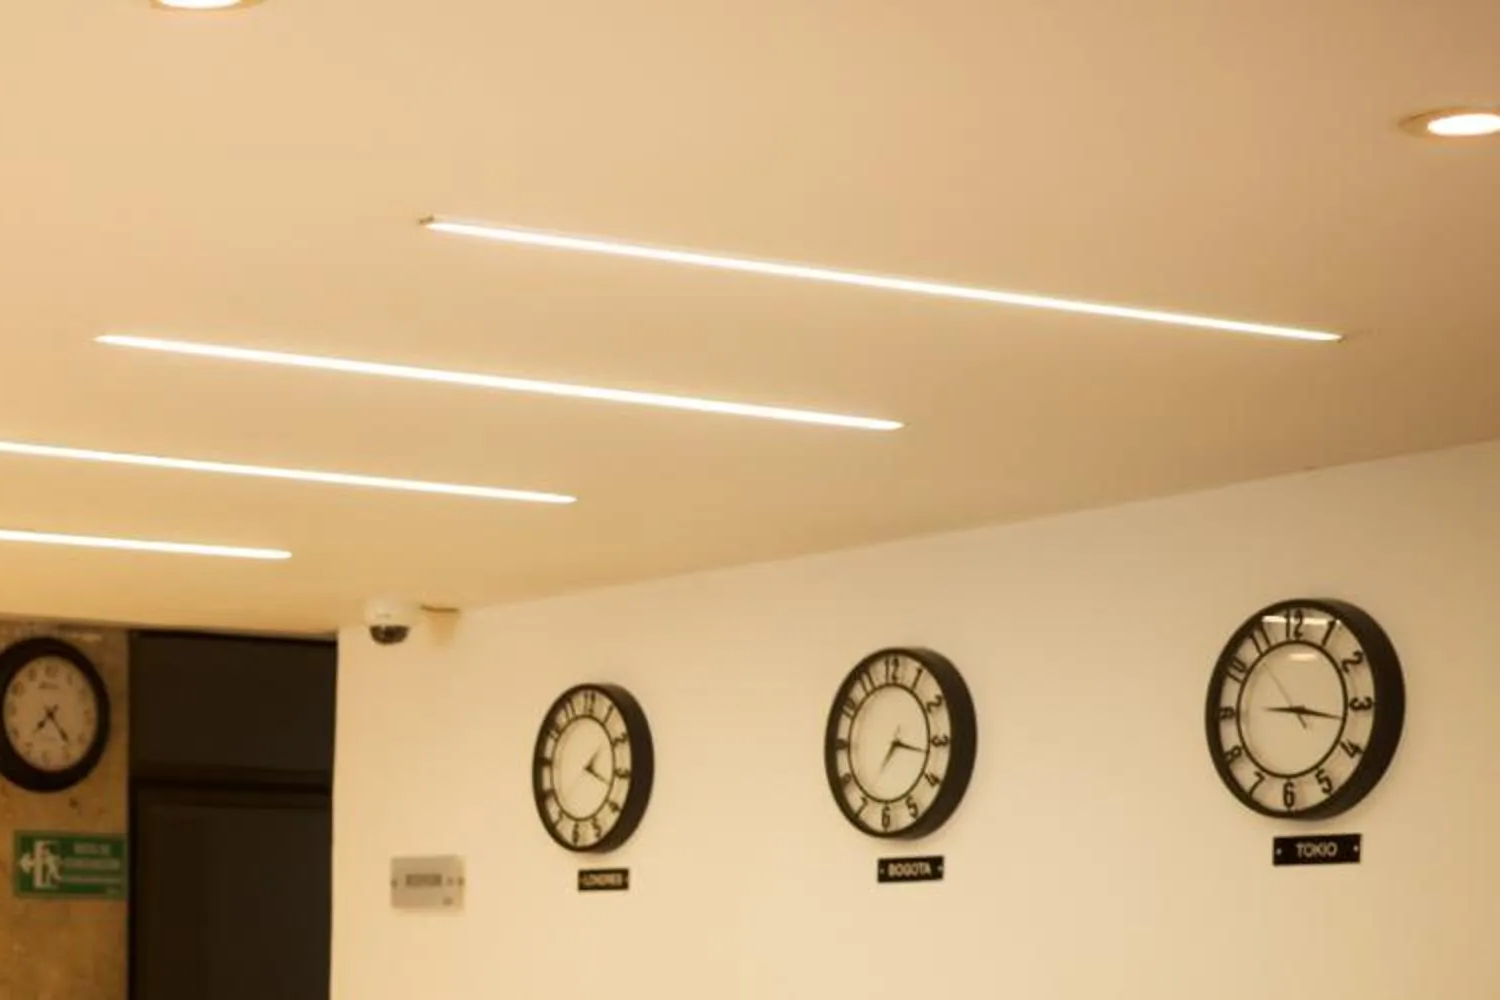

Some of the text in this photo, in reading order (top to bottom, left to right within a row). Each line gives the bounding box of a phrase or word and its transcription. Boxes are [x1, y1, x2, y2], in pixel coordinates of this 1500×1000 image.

[1285, 608, 1304, 638] 12
[1321, 620, 1337, 647] 1
[884, 656, 900, 681] 12
[1340, 651, 1364, 673] 2
[911, 667, 924, 690] 1
[926, 695, 943, 713] 2
[1349, 696, 1373, 713] 3
[930, 734, 950, 748] 3
[1339, 739, 1364, 759] 4
[924, 771, 941, 788] 4
[1248, 770, 1266, 798] 7
[1314, 768, 1334, 795] 5
[1282, 780, 1296, 808] 6
[881, 804, 891, 830] 6
[905, 796, 919, 819] 5
[1296, 841, 1338, 858] TOKIO
[888, 861, 931, 878] BOGOTA
